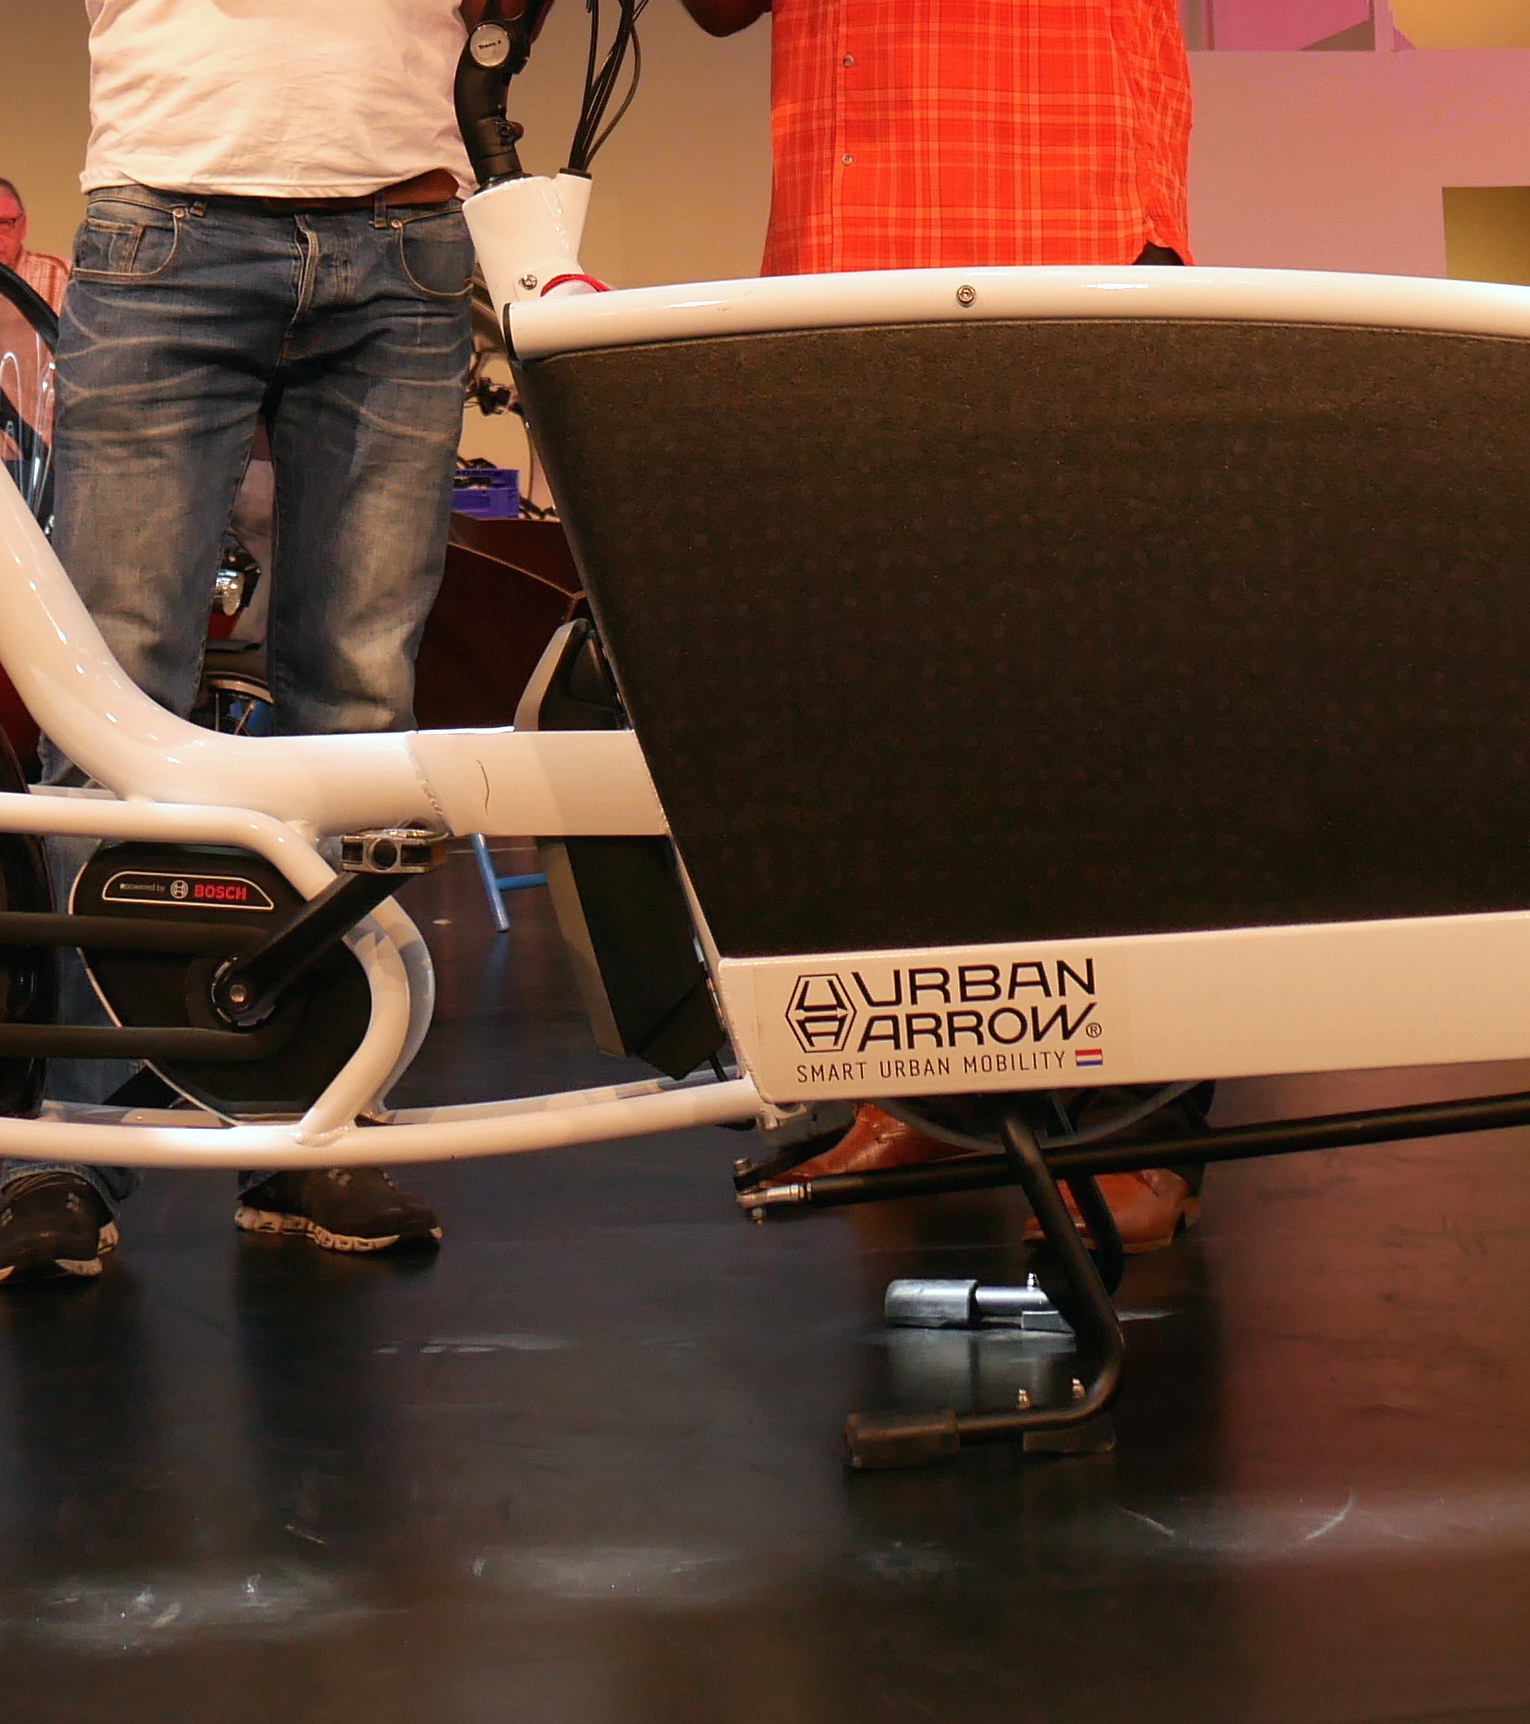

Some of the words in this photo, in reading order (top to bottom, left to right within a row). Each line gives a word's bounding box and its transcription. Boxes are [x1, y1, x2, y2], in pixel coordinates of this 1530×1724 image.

[194, 884, 247, 900] BOSCH
[851, 958, 1098, 1007] URBAN
[796, 1061, 867, 1084] SMART
[880, 1057, 950, 1079] URBAN
[964, 1050, 1066, 1075] MOBILITY
